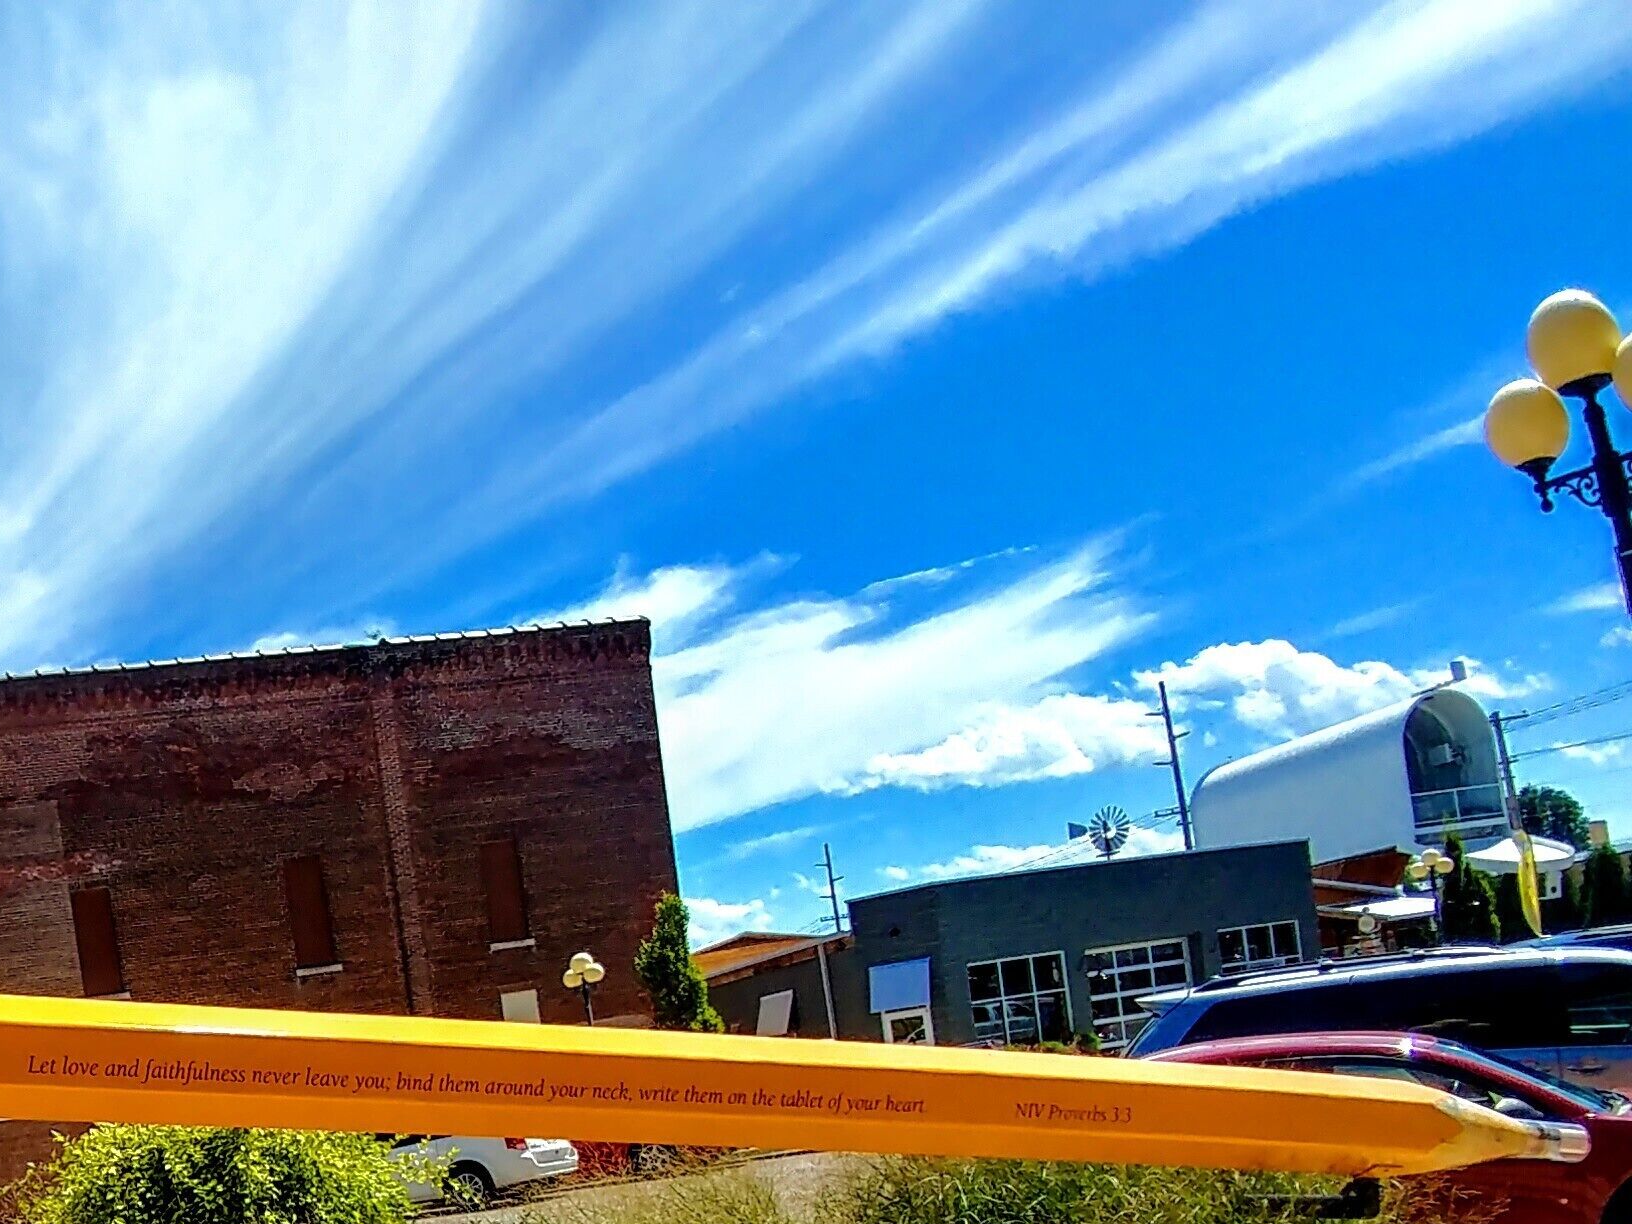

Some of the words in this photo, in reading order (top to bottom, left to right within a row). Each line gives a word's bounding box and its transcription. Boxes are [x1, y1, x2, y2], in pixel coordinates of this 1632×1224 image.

[27, 1054, 57, 1075] Let
[62, 1054, 99, 1077] love
[104, 1057, 140, 1078] and
[140, 1058, 246, 1086] faithfulness
[251, 1070, 302, 1086] never
[304, 1066, 350, 1088] leave
[396, 1071, 435, 1092] bind
[438, 1072, 480, 1093] them
[484, 1077, 546, 1097] around
[547, 1084, 590, 1103] your
[638, 1086, 680, 1103] write
[683, 1084, 723, 1104] them
[727, 1092, 747, 1105] on
[751, 1087, 777, 1107] the
[780, 1088, 824, 1109] tablet
[827, 1091, 844, 1115] of
[843, 1098, 883, 1116] your
[1047, 1104, 1107, 1122] Proverbs
